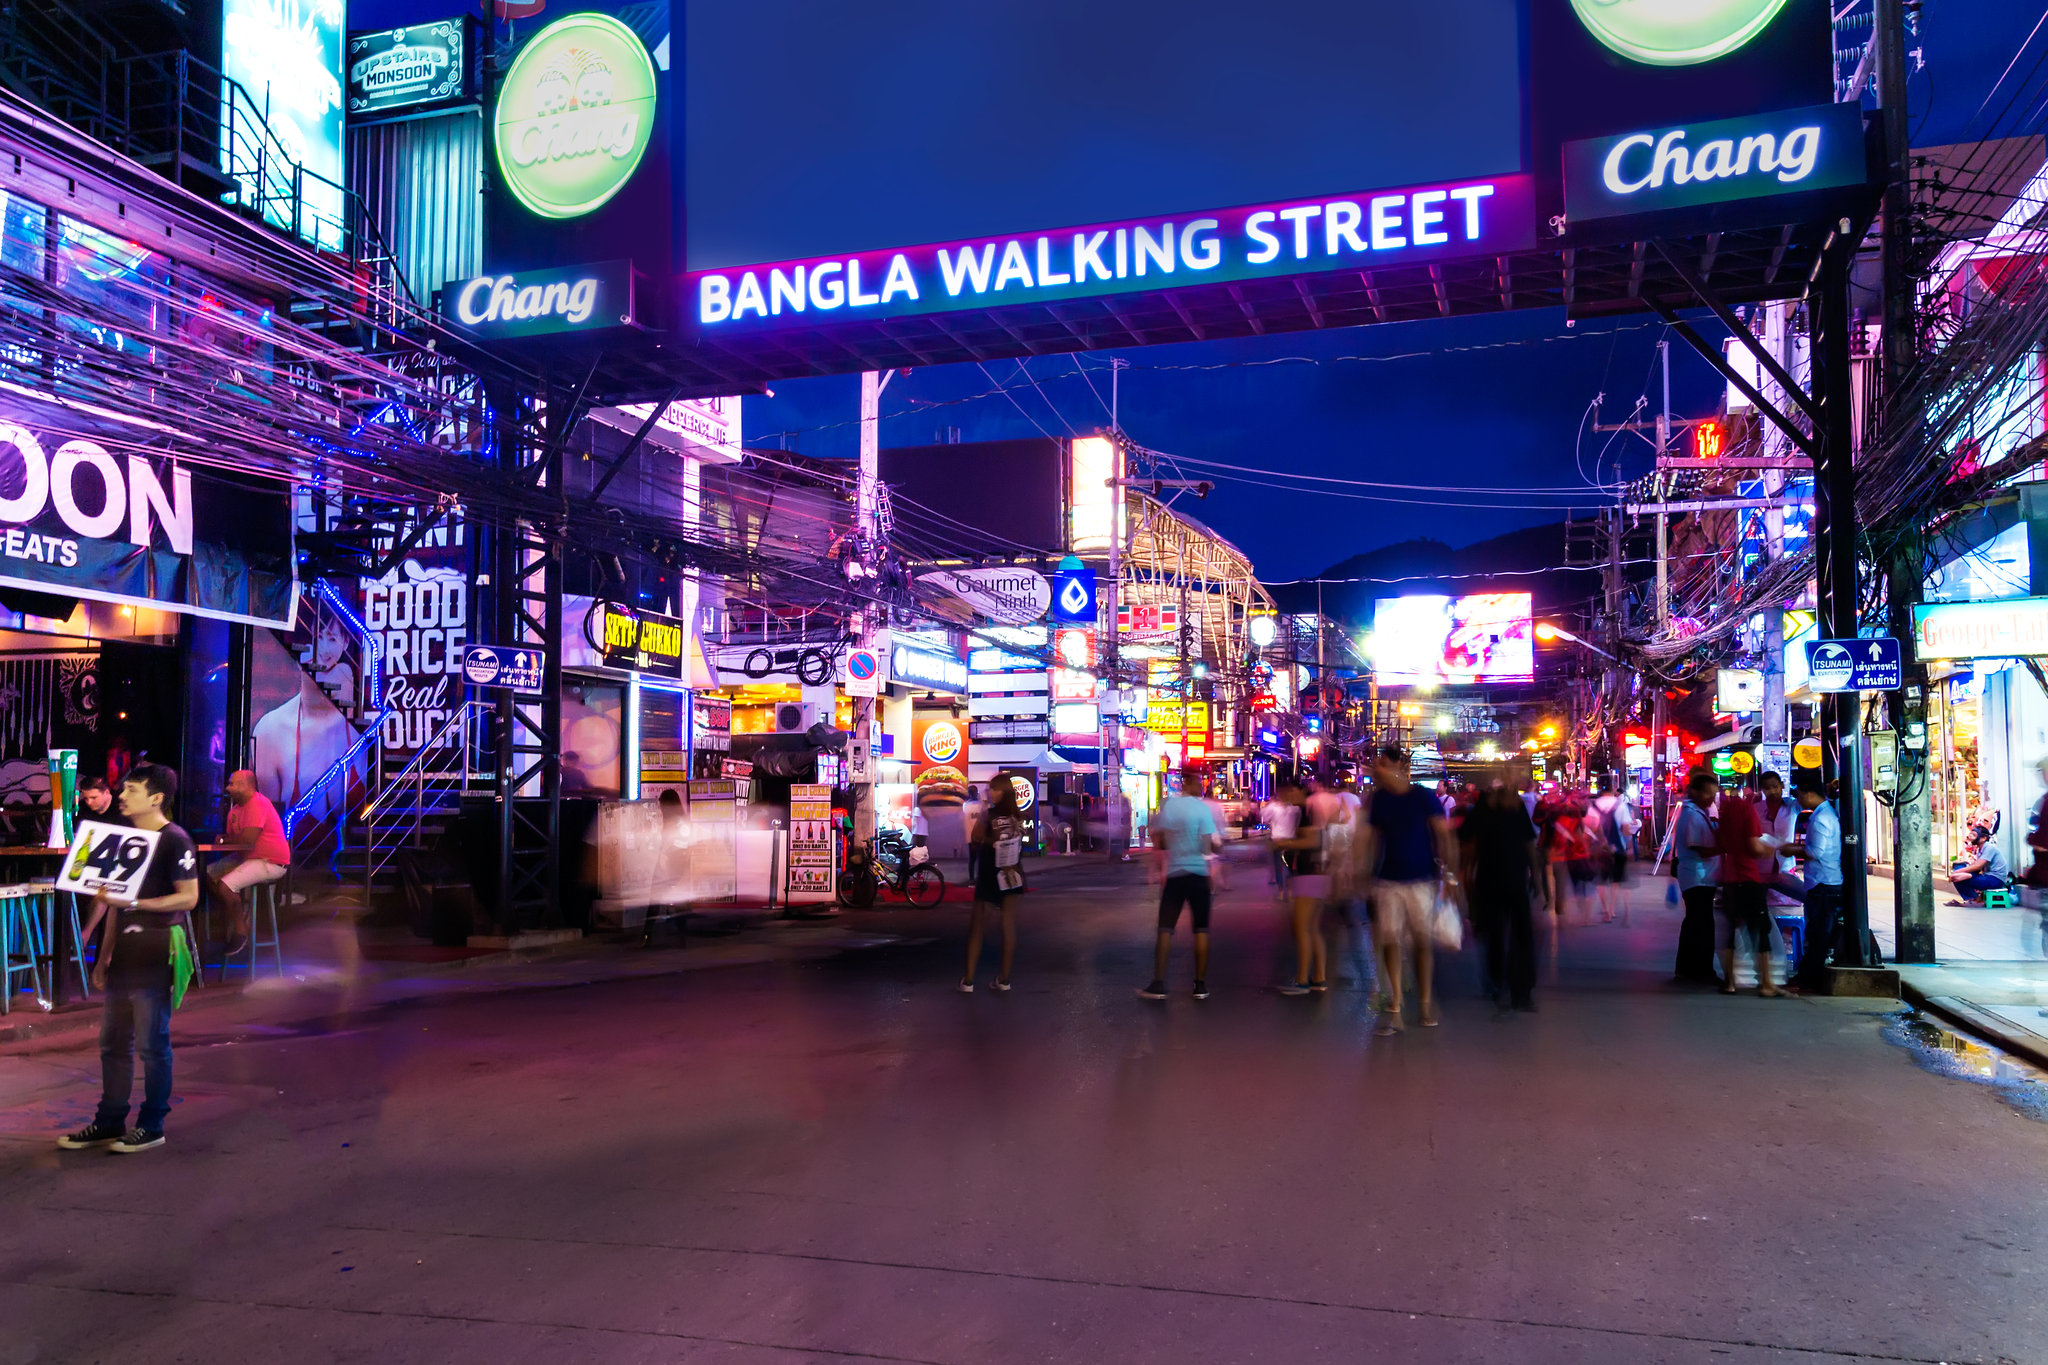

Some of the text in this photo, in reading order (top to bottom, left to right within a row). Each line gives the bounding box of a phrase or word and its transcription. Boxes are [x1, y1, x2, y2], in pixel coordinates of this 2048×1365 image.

[357, 48, 441, 75] UPSTAIRS
[366, 63, 432, 87] MONSOON
[511, 114, 639, 168] Chang
[1602, 127, 1821, 194] Chang
[699, 184, 1495, 325] BANGLA WALKING STREET
[458, 276, 597, 325] Chang
[956, 575, 1037, 594] Gourmet
[365, 581, 467, 631] GOOD
[1139, 607, 1152, 629] 1
[605, 612, 682, 658] SETH GUEKO
[1922, 617, 2000, 650] George
[364, 628, 466, 677] PRICE
[468, 660, 498, 669] TSUNAMI
[1815, 660, 1851, 669] TSUNAMI
[1855, 660, 1898, 672] เส้นทางหนี
[384, 676, 449, 710] Real
[1857, 671, 1897, 686] คลื่นยักษ์
[364, 709, 466, 750] TOUCH
[928, 732, 955, 744] BURGER
[929, 737, 956, 754] KING
[1016, 790, 1031, 800] NG
[86, 833, 150, 882] 49
